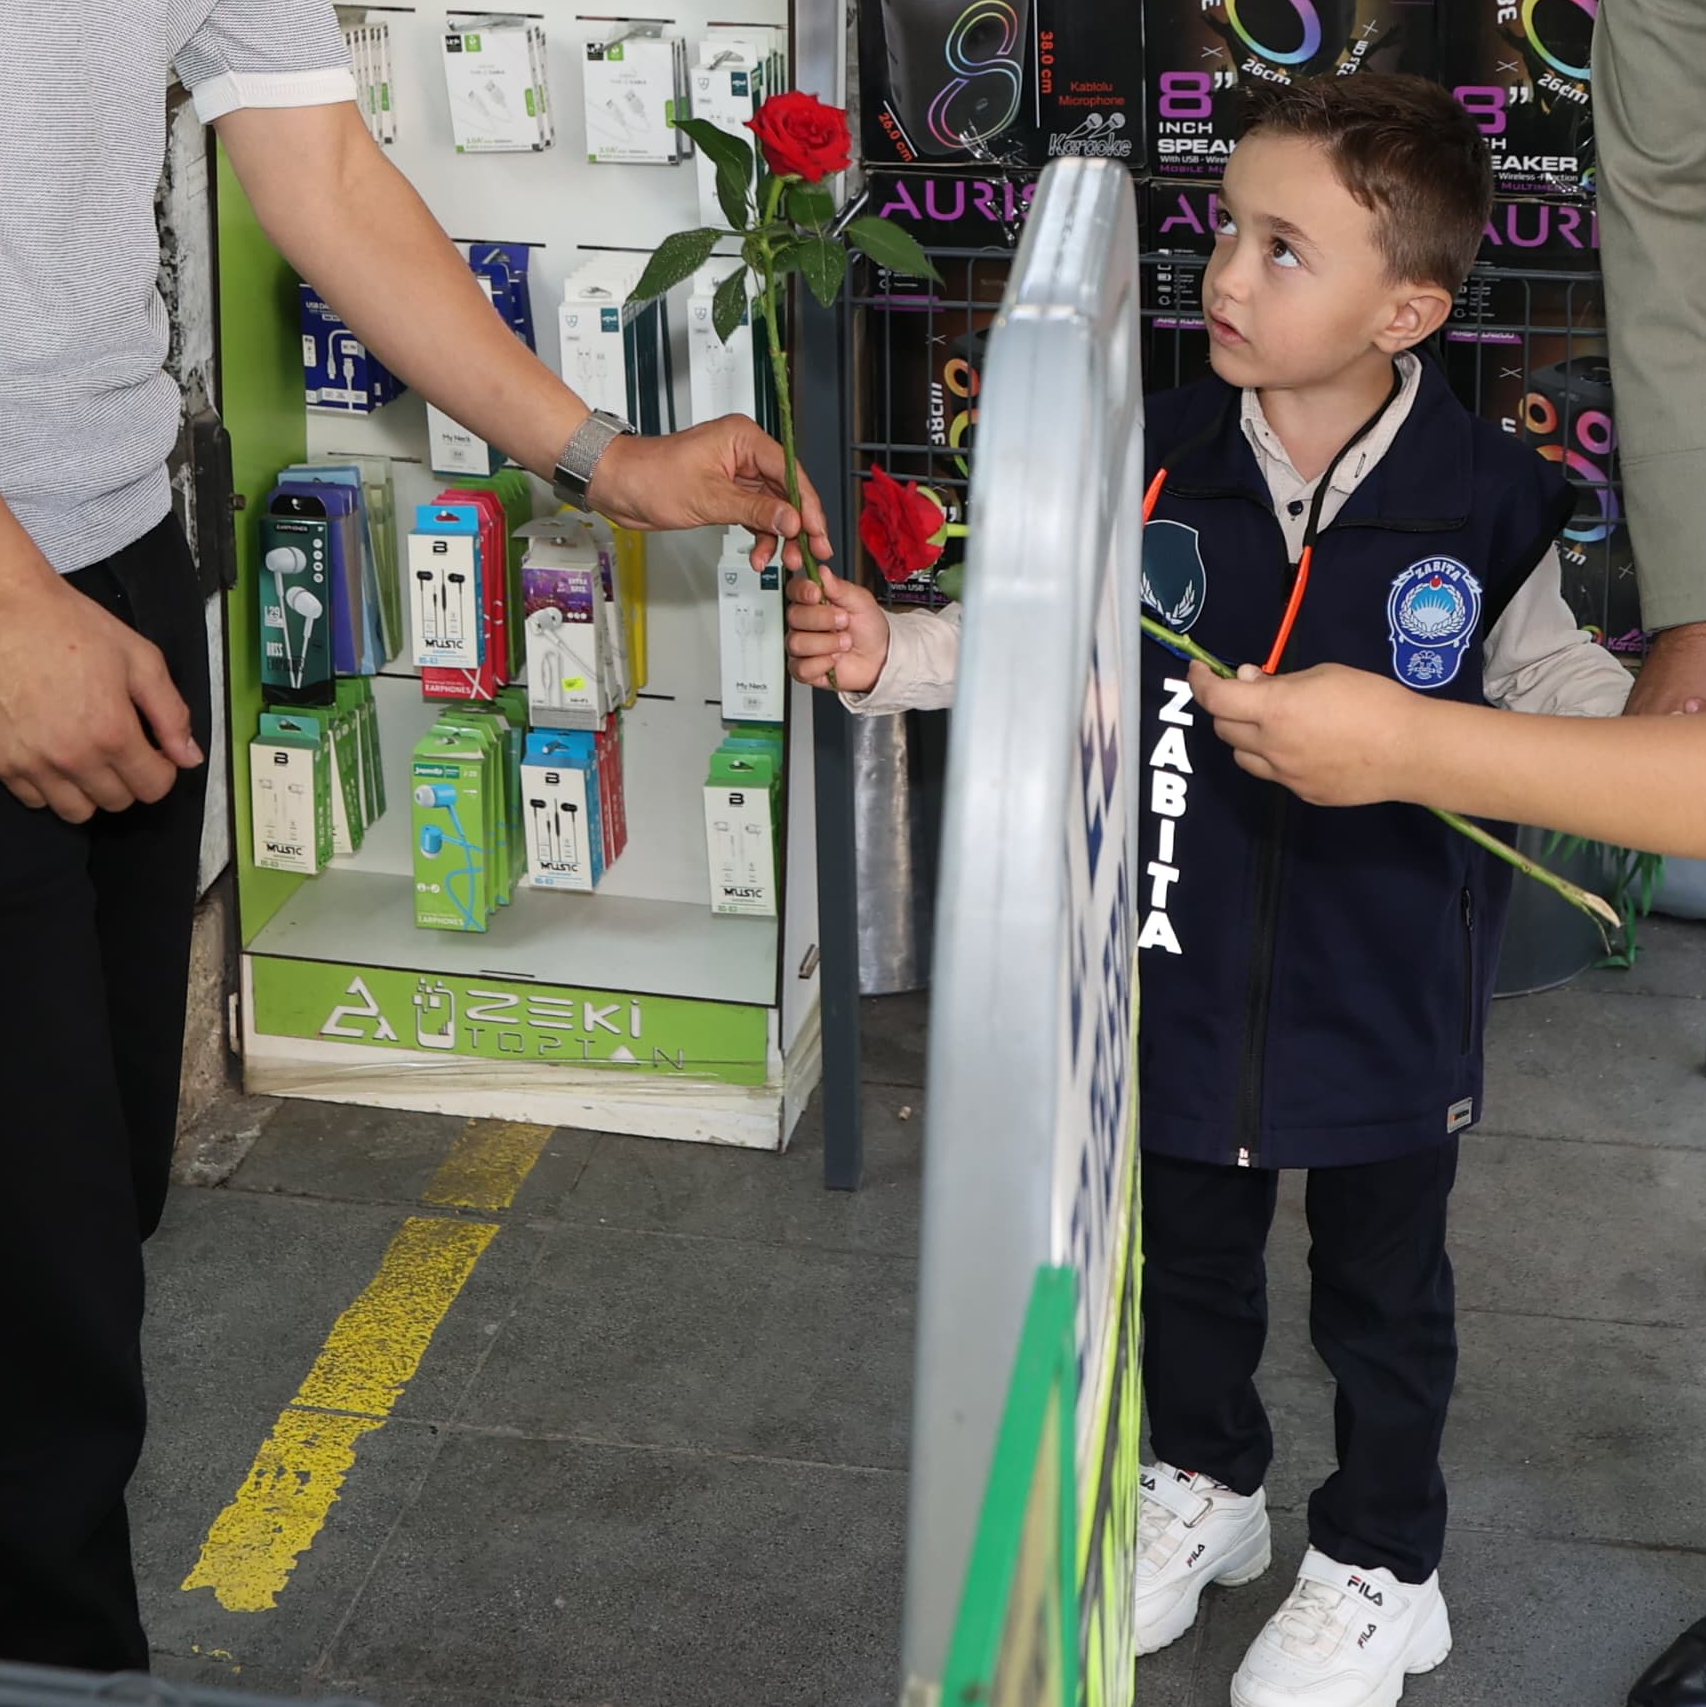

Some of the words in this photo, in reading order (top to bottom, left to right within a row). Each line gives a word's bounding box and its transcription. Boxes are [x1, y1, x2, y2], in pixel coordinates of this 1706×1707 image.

[1039, 30, 1055, 66] 38.0
[1040, 68, 1053, 95] cm
[1240, 56, 1293, 87] 26cm
[1070, 81, 1114, 93] Kablolu
[1536, 72, 1590, 106] 26cm
[1058, 94, 1126, 109] Microphone
[877, 111, 902, 141] 26.0
[895, 140, 913, 163] cm
[1158, 121, 1214, 135] INCH
[1048, 132, 1133, 157] Karaoke
[1159, 155, 1181, 164] With
[1181, 155, 1200, 164] USB
[1414, 560, 1463, 583] ZABITA
[424, 684, 472, 695] EARPHONES
[736, 682, 748, 691] My
[749, 682, 768, 690] Neck
[1136, 675, 1195, 956] ZABITA
[1185, 1542, 1206, 1569] FILA
[1346, 1574, 1384, 1608] FILA
[1356, 1622, 1378, 1649] FILA
